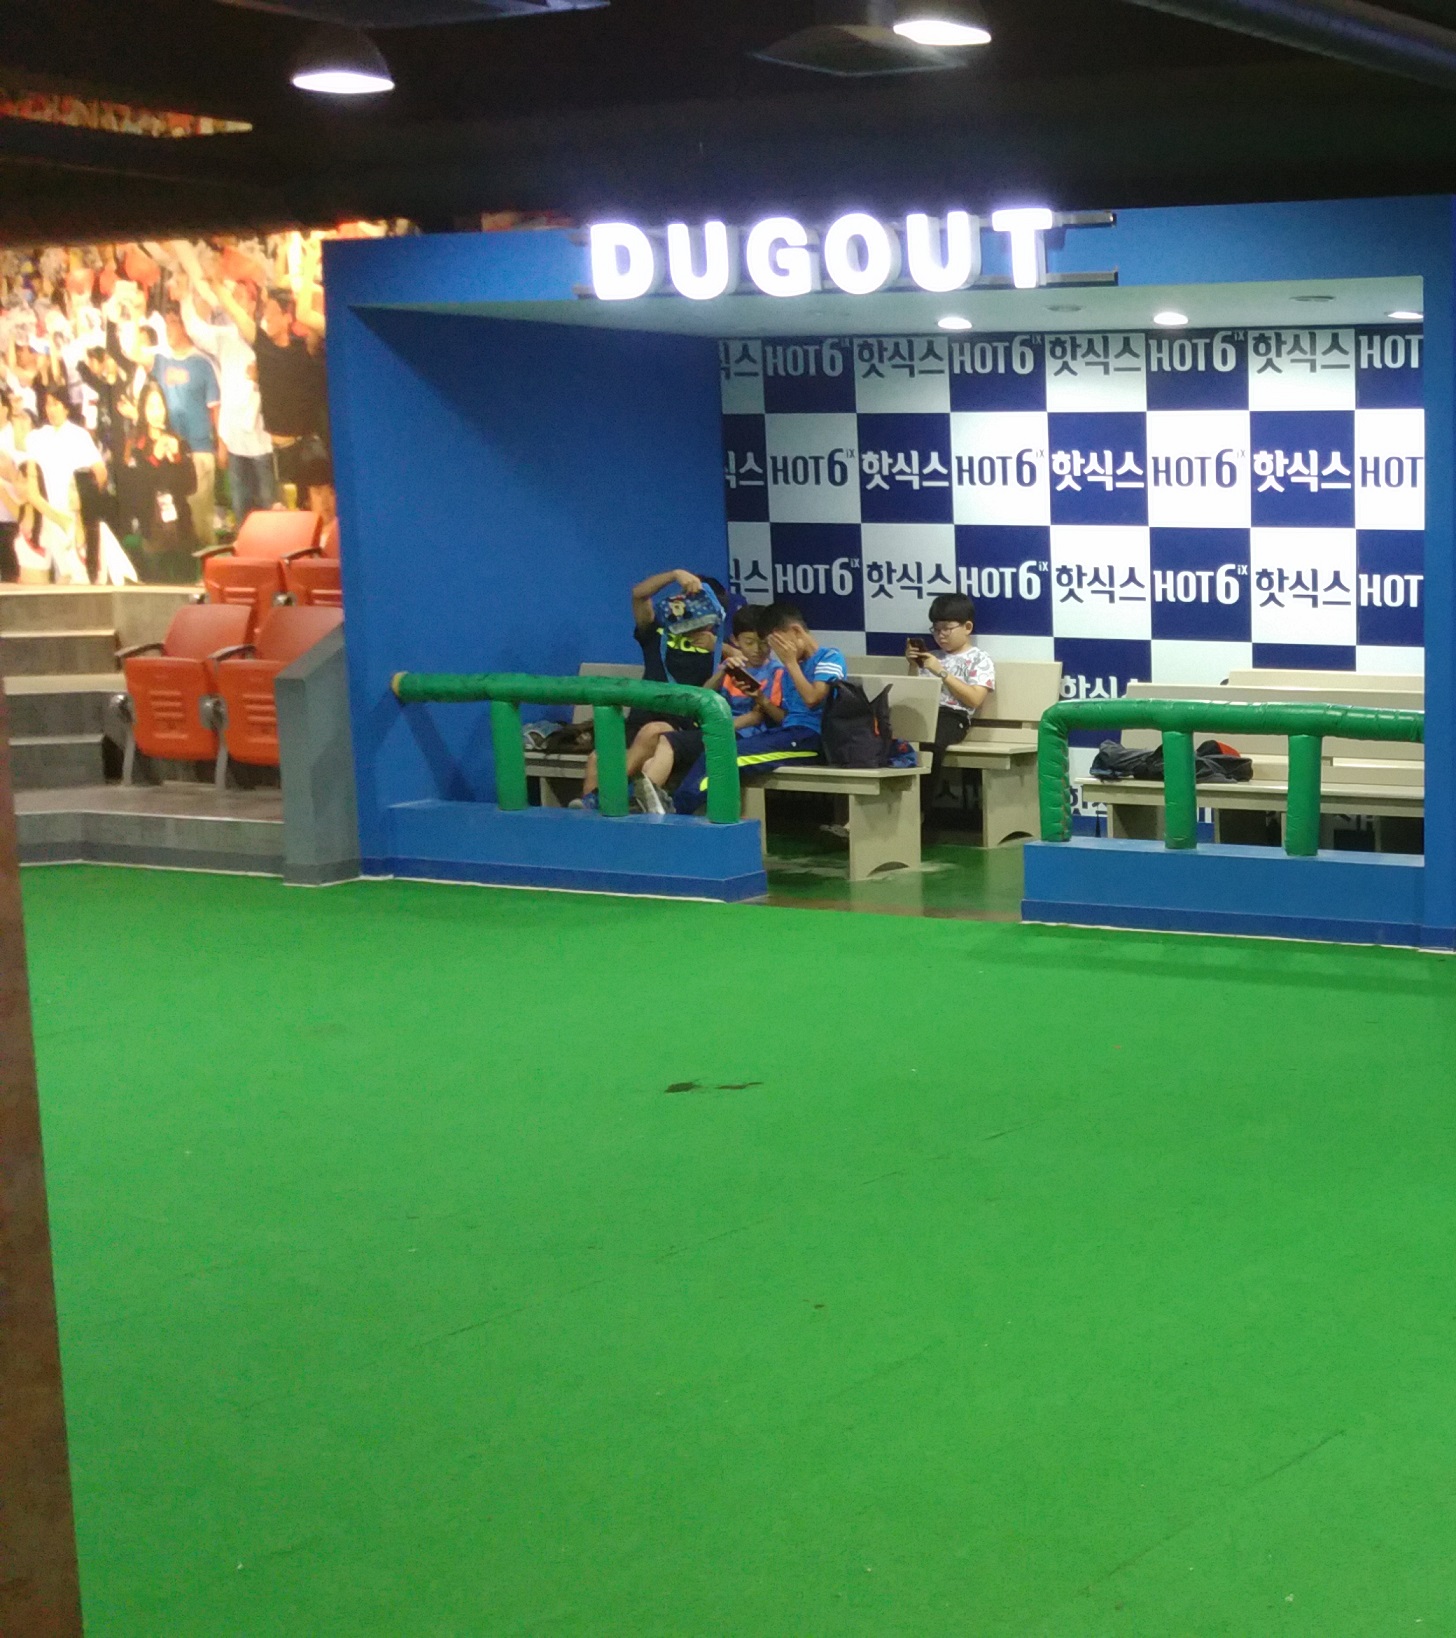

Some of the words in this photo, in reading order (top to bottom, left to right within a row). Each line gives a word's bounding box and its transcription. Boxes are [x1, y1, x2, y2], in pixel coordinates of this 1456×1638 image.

[589, 208, 1055, 300] DUGOUT
[857, 339, 946, 378] 핫식스
[1049, 333, 1142, 377] 핫식스
[1252, 332, 1351, 374] 핫식스
[861, 450, 949, 490] 핫식스
[1051, 450, 1145, 492] 핫식스
[1253, 450, 1352, 493] 핫식스
[866, 561, 952, 599] 핫식스
[1055, 565, 1146, 604] 핫식스
[1256, 568, 1351, 608] 핫식스
